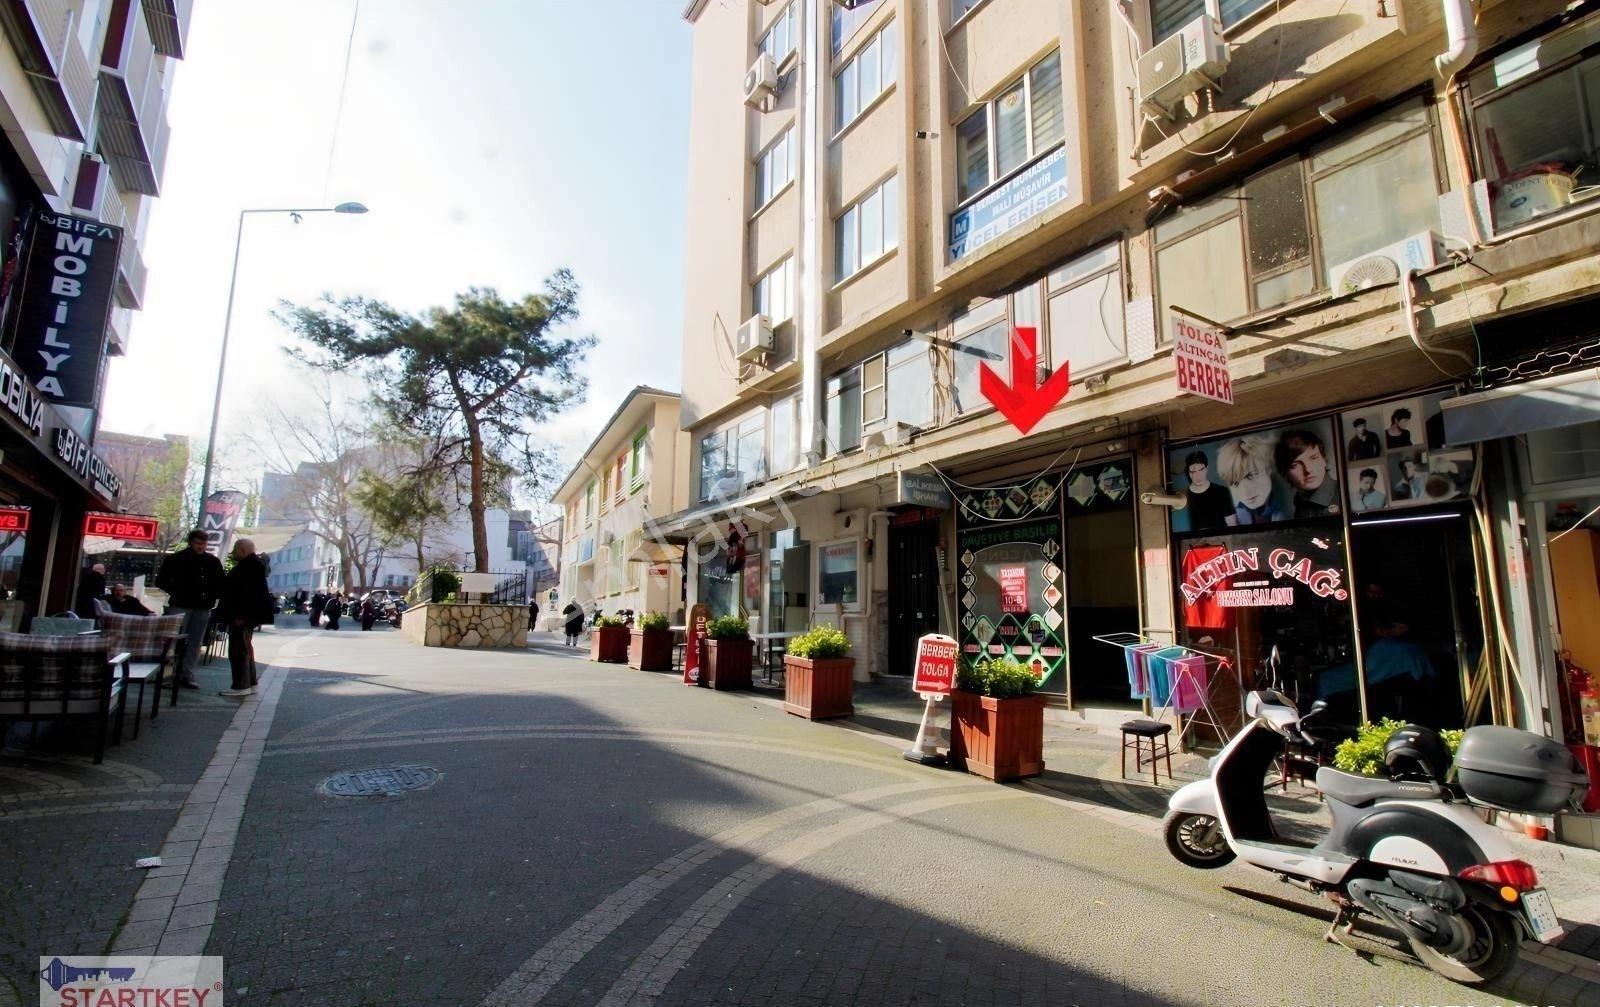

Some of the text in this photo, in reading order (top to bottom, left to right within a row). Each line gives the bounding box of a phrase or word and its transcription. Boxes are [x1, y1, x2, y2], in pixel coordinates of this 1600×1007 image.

[35, 231, 94, 398] MOBİLYA
[1177, 322, 1223, 349] TOLGA
[1177, 355, 1232, 402] BERBER
[91, 453, 122, 498] CONCEPT
[95, 521, 114, 533] BY
[1180, 548, 1341, 606] ALTIN ÇAĞ
[1253, 587, 1294, 607] SALONU
[921, 643, 955, 660] BERBER
[921, 661, 950, 678] TOLGA
